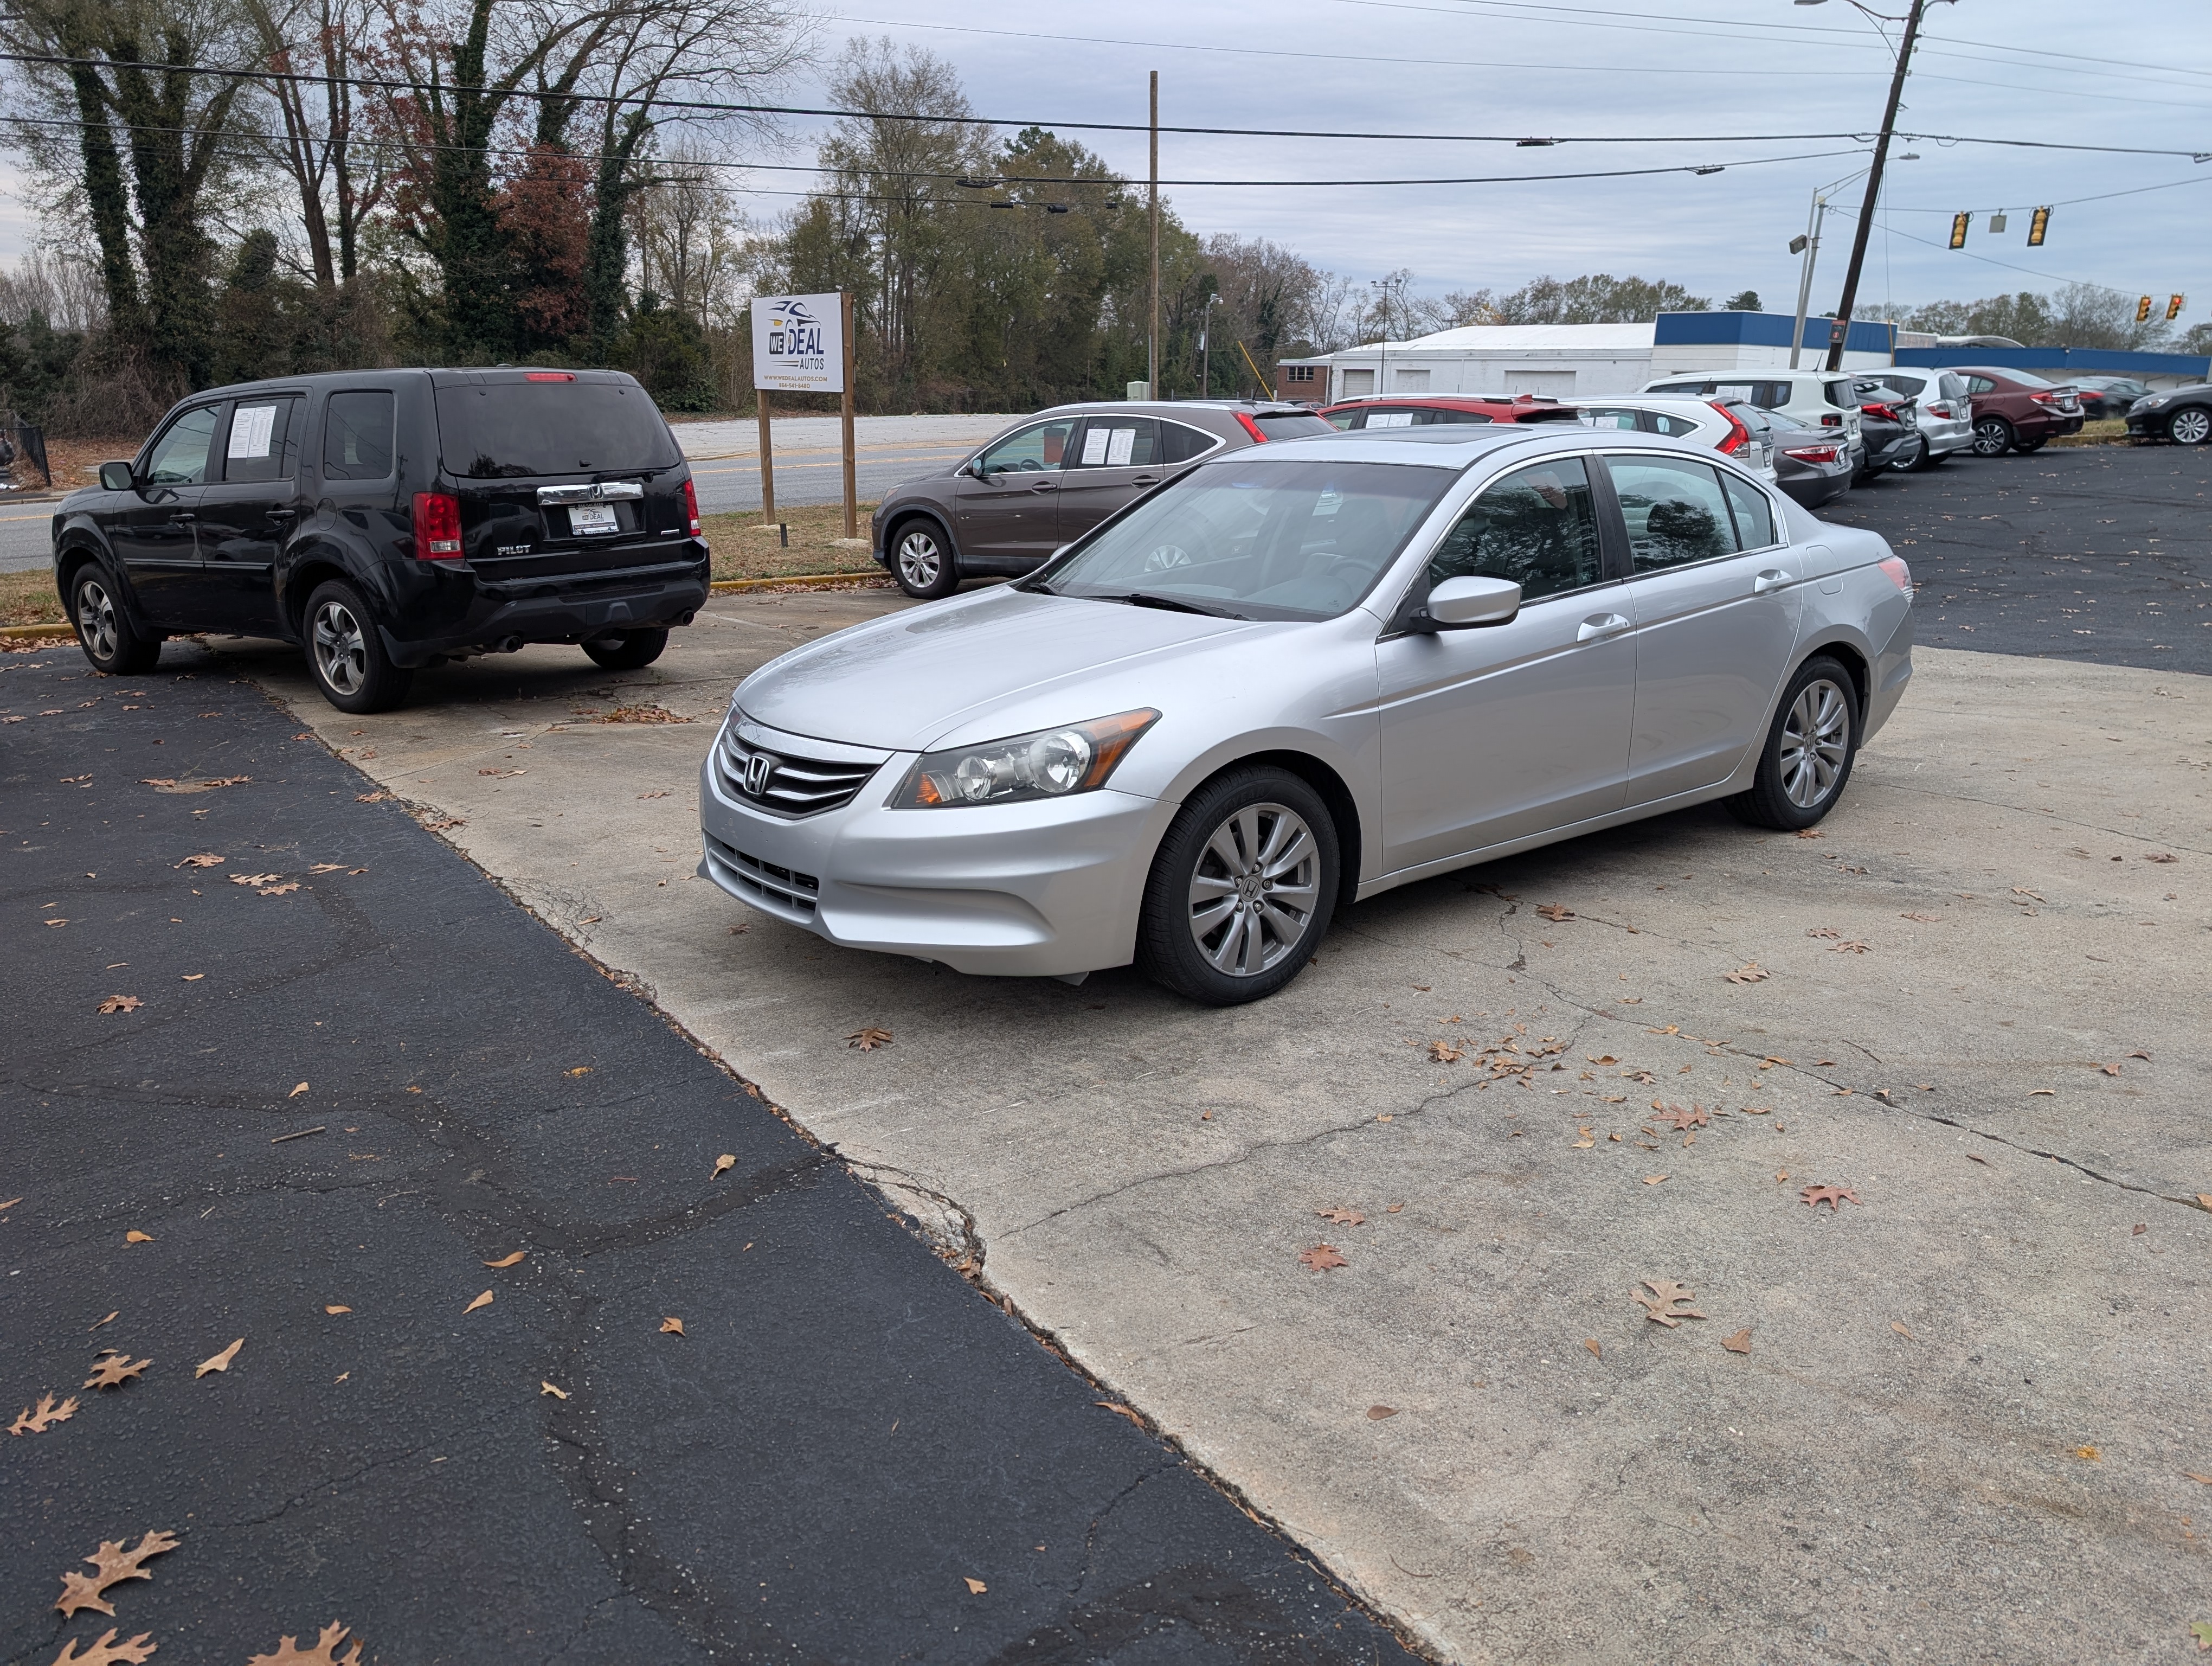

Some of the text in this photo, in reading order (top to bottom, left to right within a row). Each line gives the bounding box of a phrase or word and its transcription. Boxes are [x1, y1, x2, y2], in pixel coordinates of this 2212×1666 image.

[770, 328, 824, 355] WE DEAL
[799, 357, 825, 370] AUTOS
[497, 544, 531, 555] PILOT
[1265, 941, 1312, 990] RELIANT
